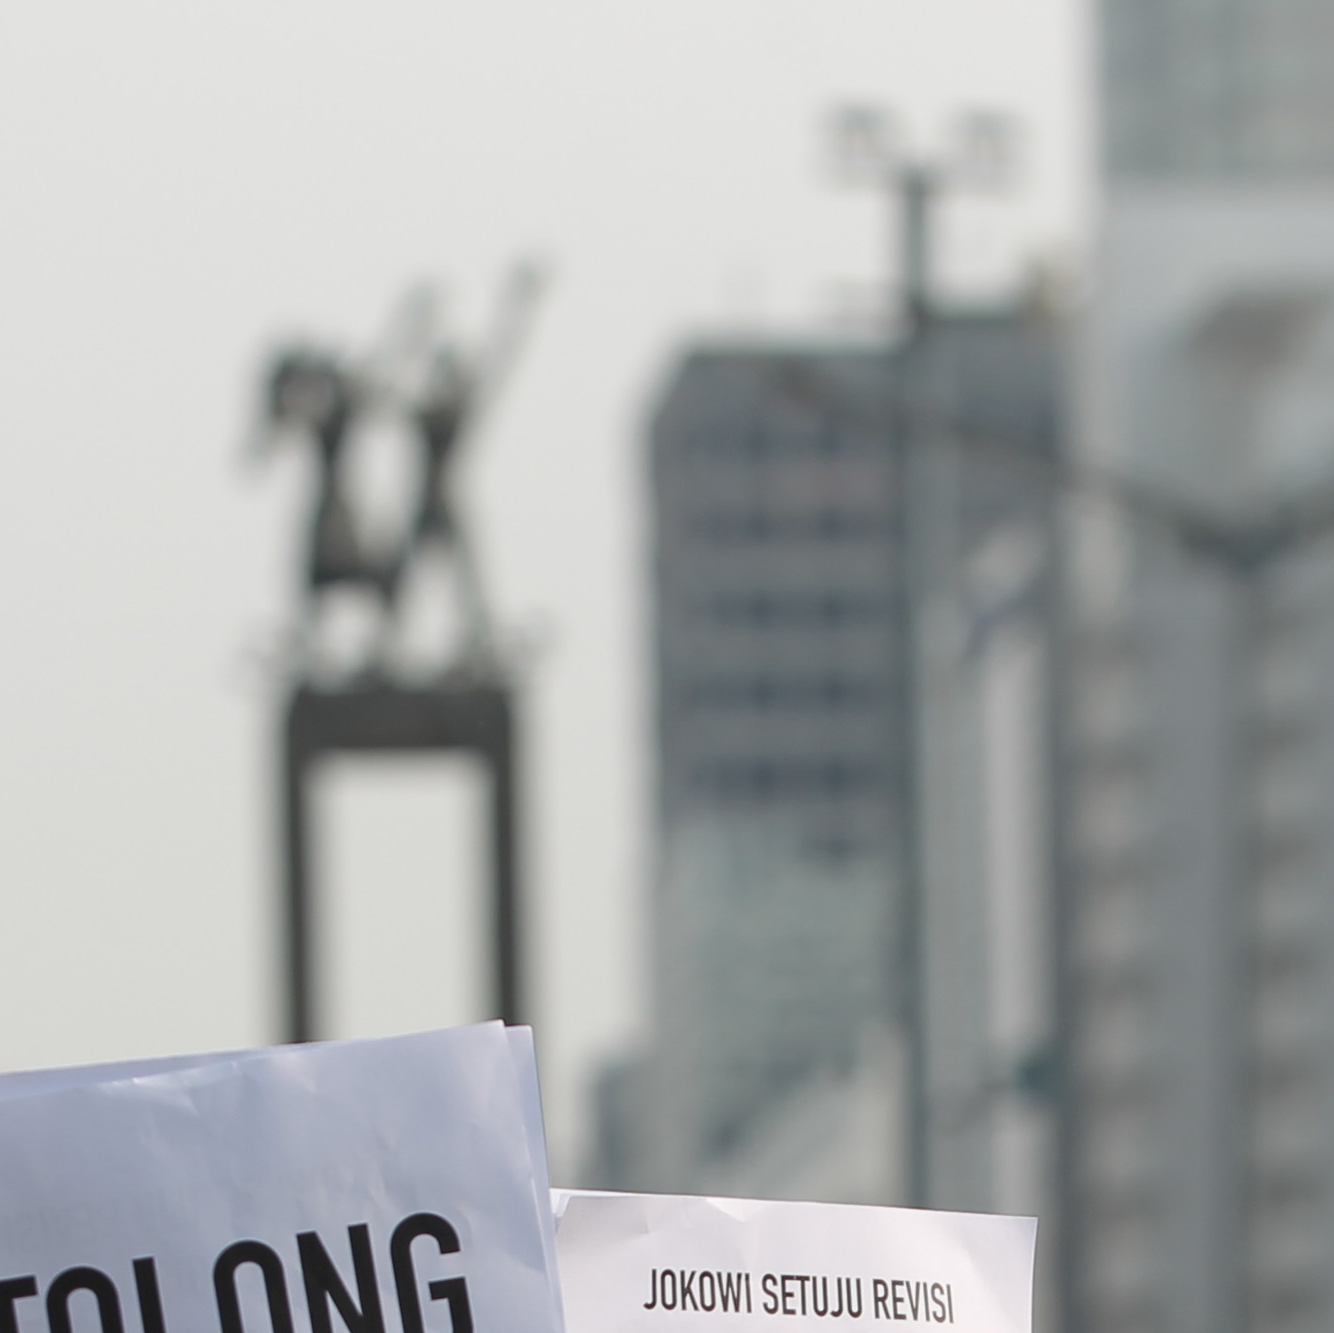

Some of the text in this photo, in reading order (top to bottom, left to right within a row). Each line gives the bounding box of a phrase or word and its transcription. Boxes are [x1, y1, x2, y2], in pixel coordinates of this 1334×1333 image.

[642, 1268, 955, 1324] JOKOWI SETUJU REVISI
